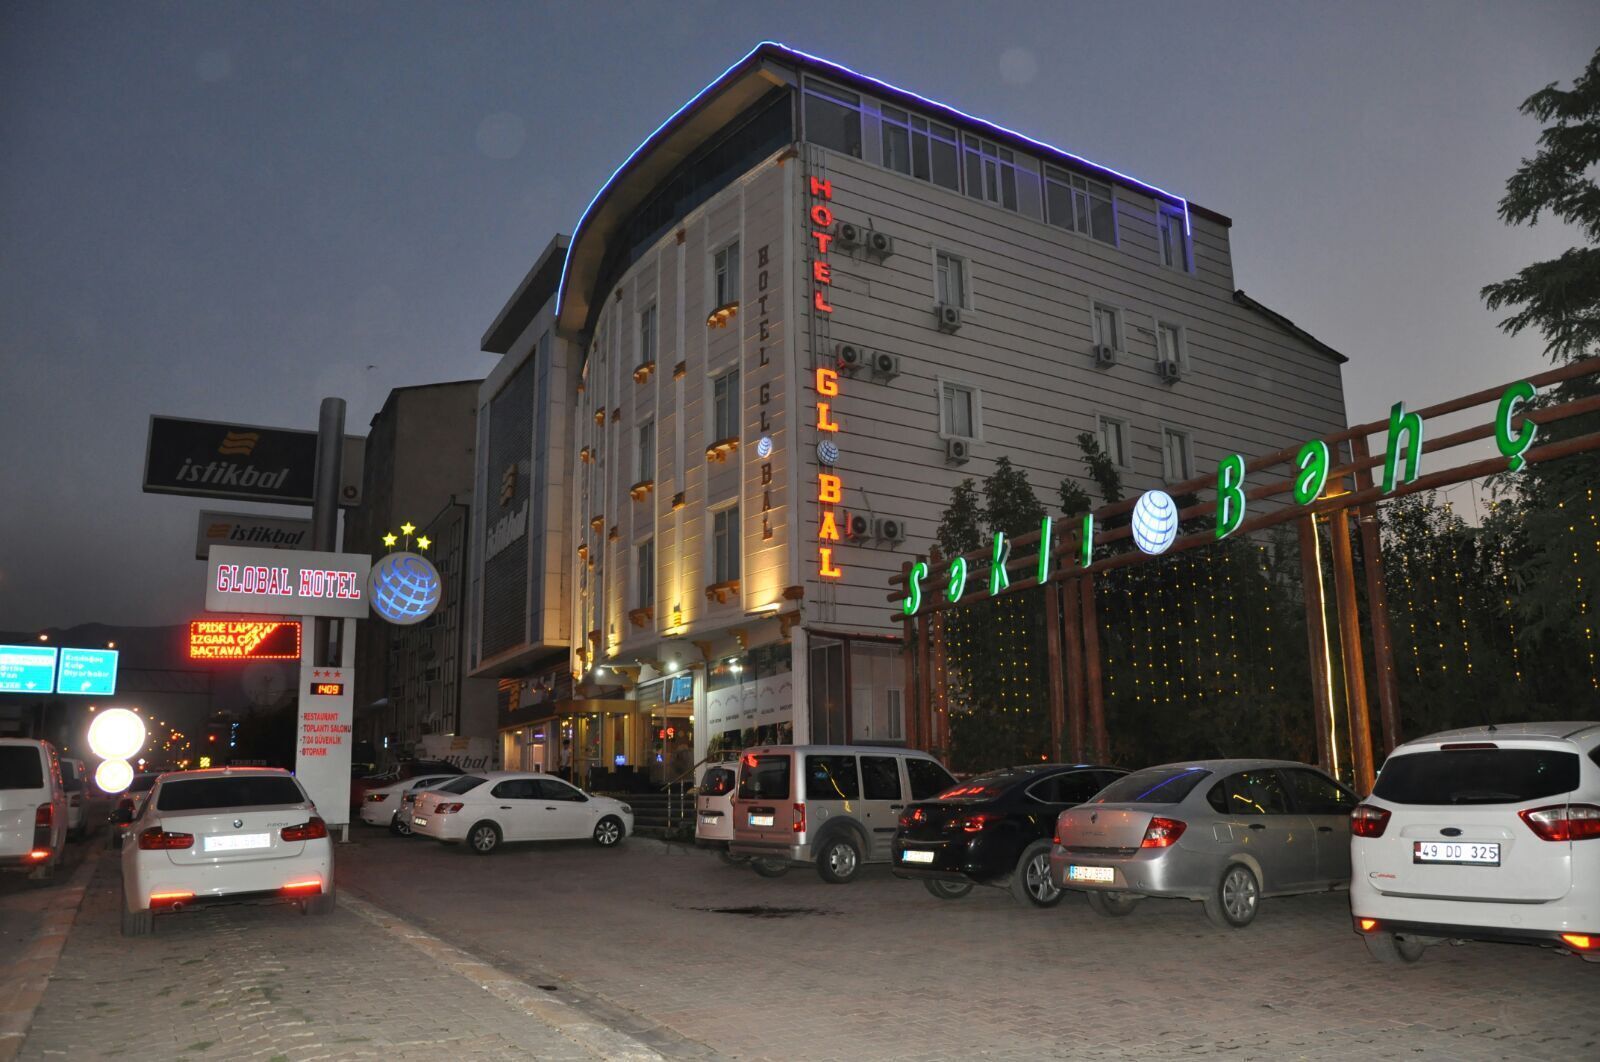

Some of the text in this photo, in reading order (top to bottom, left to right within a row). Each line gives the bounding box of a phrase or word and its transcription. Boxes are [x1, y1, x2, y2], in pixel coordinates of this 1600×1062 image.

[810, 176, 833, 314] HOTEL
[758, 244, 770, 368] HOTEL
[176, 457, 290, 490] istikbal
[230, 524, 305, 545] istikbal
[216, 564, 361, 600] GLOBAL HOTEL
[303, 712, 339, 721] RESTAURANT
[1422, 844, 1497, 859] 49 DD 325
